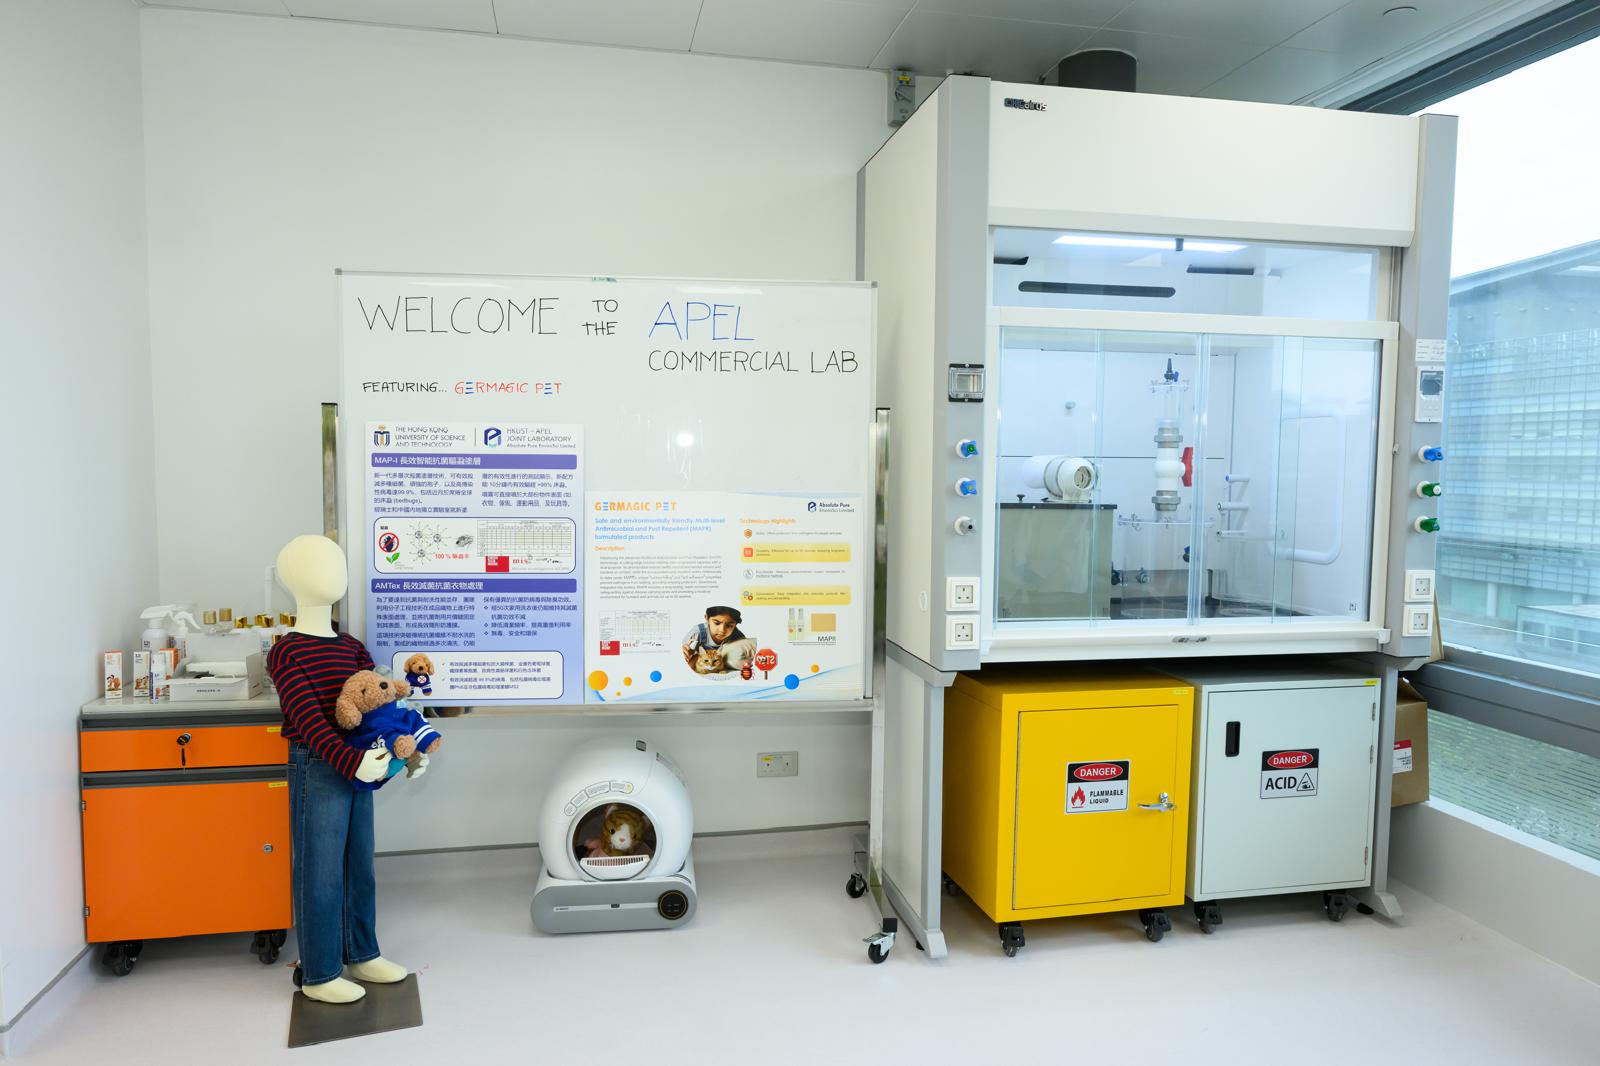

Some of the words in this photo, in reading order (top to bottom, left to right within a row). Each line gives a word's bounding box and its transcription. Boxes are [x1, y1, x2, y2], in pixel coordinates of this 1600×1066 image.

[592, 298, 619, 314] TO
[357, 296, 560, 336] WELCOME
[648, 301, 756, 341] APEL
[582, 321, 617, 337] THE
[648, 349, 799, 374] COMMERCIAL
[809, 351, 859, 374] LAB
[362, 381, 448, 394] FEATURING...
[454, 380, 529, 395] GERMAGIC
[535, 381, 562, 395] PET
[594, 501, 650, 512] GERMAGIC
[655, 501, 677, 512] PET
[1273, 755, 1308, 765] DANGER
[1080, 767, 1117, 777] DANGER
[1265, 776, 1297, 790] ACID
[1090, 789, 1124, 797] FLAMMABLE
